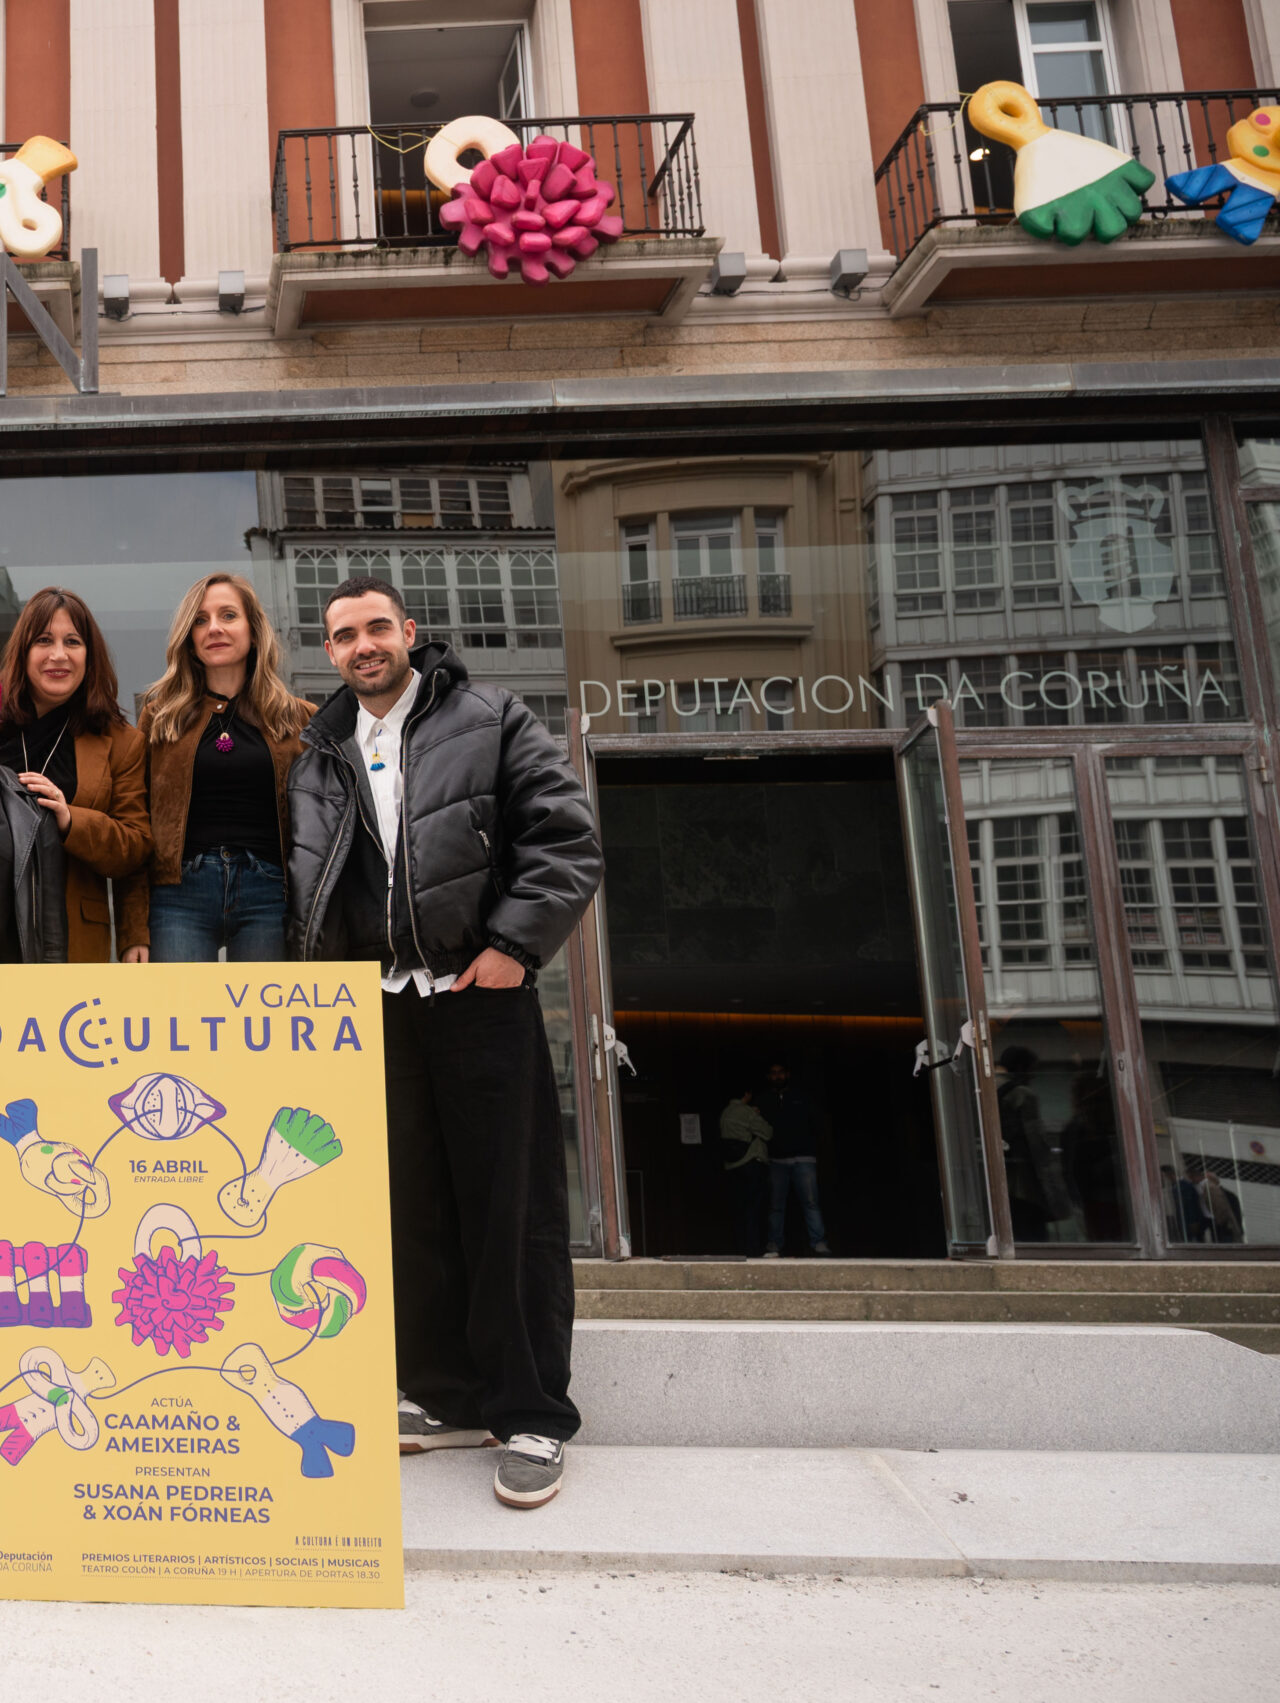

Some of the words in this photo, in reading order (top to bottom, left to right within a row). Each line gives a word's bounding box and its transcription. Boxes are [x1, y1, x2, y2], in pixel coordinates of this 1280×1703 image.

[579, 674, 894, 719] DEPUTACION
[915, 672, 986, 713] DA
[1001, 665, 1231, 711] CORUÑA
[224, 984, 250, 1009] V
[260, 983, 358, 1009] GALA
[128, 1160, 148, 1174] 16
[152, 1160, 209, 1174] ABRIL
[134, 1175, 177, 1183] ENTRADA
[178, 1175, 205, 1183] LIBRE
[150, 1395, 194, 1408] ACTÚA
[104, 1411, 220, 1432] CAAMAÑO
[225, 1415, 241, 1432] &
[104, 1437, 241, 1455] AMEIXEIRAS
[135, 1466, 211, 1478] PRESENTAN
[73, 1483, 160, 1501] SUSANA
[166, 1485, 275, 1503] PEDREIRA
[82, 1504, 97, 1521] &
[103, 1502, 163, 1521] XOÁN
[170, 1503, 271, 1524] FÓRNEAS
[295, 1535, 300, 1546] A
[302, 1536, 333, 1547] CULTURA
[335, 1534, 340, 1547] É
[341, 1537, 351, 1547] UN
[354, 1537, 382, 1548] DEREITO
[12, 1561, 53, 1572] CORUÑA
[81, 1553, 130, 1562] PREMIOS
[133, 1554, 196, 1564] LITERARIOS
[204, 1554, 267, 1566] ARTÍSTICOS
[275, 1557, 319, 1567] SOCIAIS
[327, 1558, 380, 1568] MUSICAIS
[81, 1564, 119, 1573] TEATRO
[121, 1564, 156, 1574] COLÓN
[173, 1565, 215, 1575] CORUÑA
[218, 1568, 227, 1576] 19
[245, 1569, 297, 1577] APERTURA
[299, 1570, 313, 1578] DE
[316, 1570, 355, 1579] PORTAS
[357, 1570, 381, 1579] 18.30
